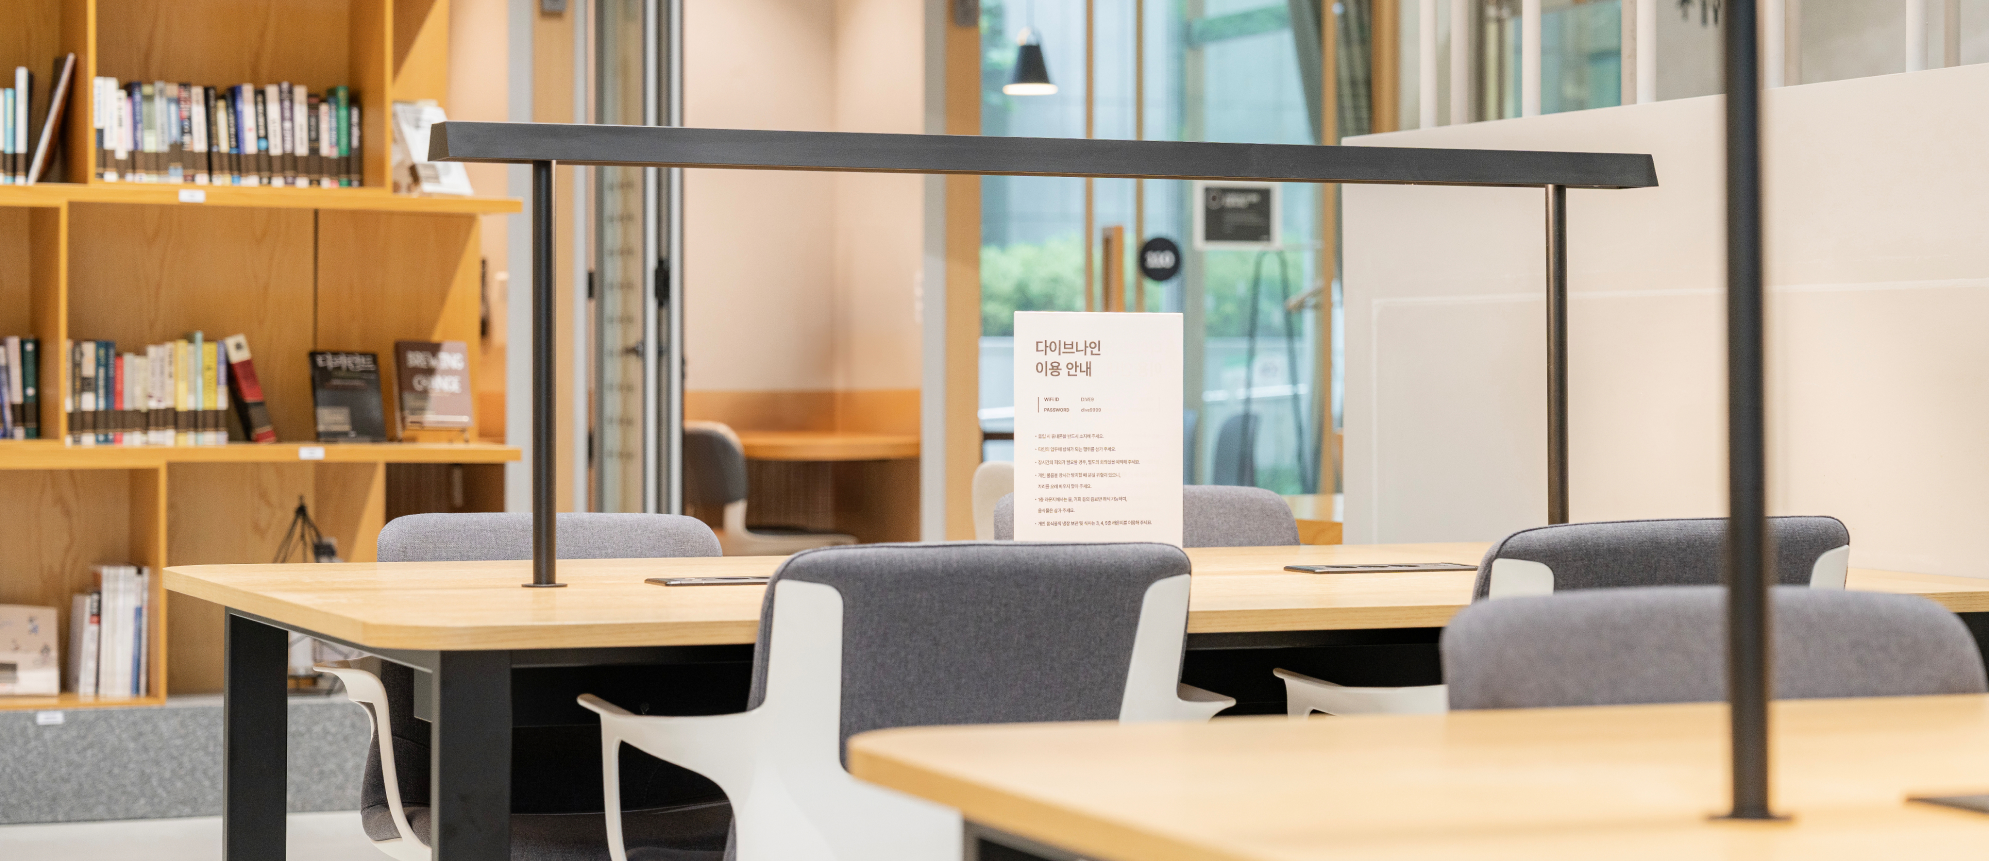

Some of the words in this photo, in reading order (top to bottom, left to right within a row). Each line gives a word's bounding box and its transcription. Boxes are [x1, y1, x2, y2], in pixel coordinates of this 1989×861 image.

[1035, 339, 1101, 356] 다이브나인
[1035, 361, 1062, 377] 이용
[1066, 361, 1092, 377] 안내
